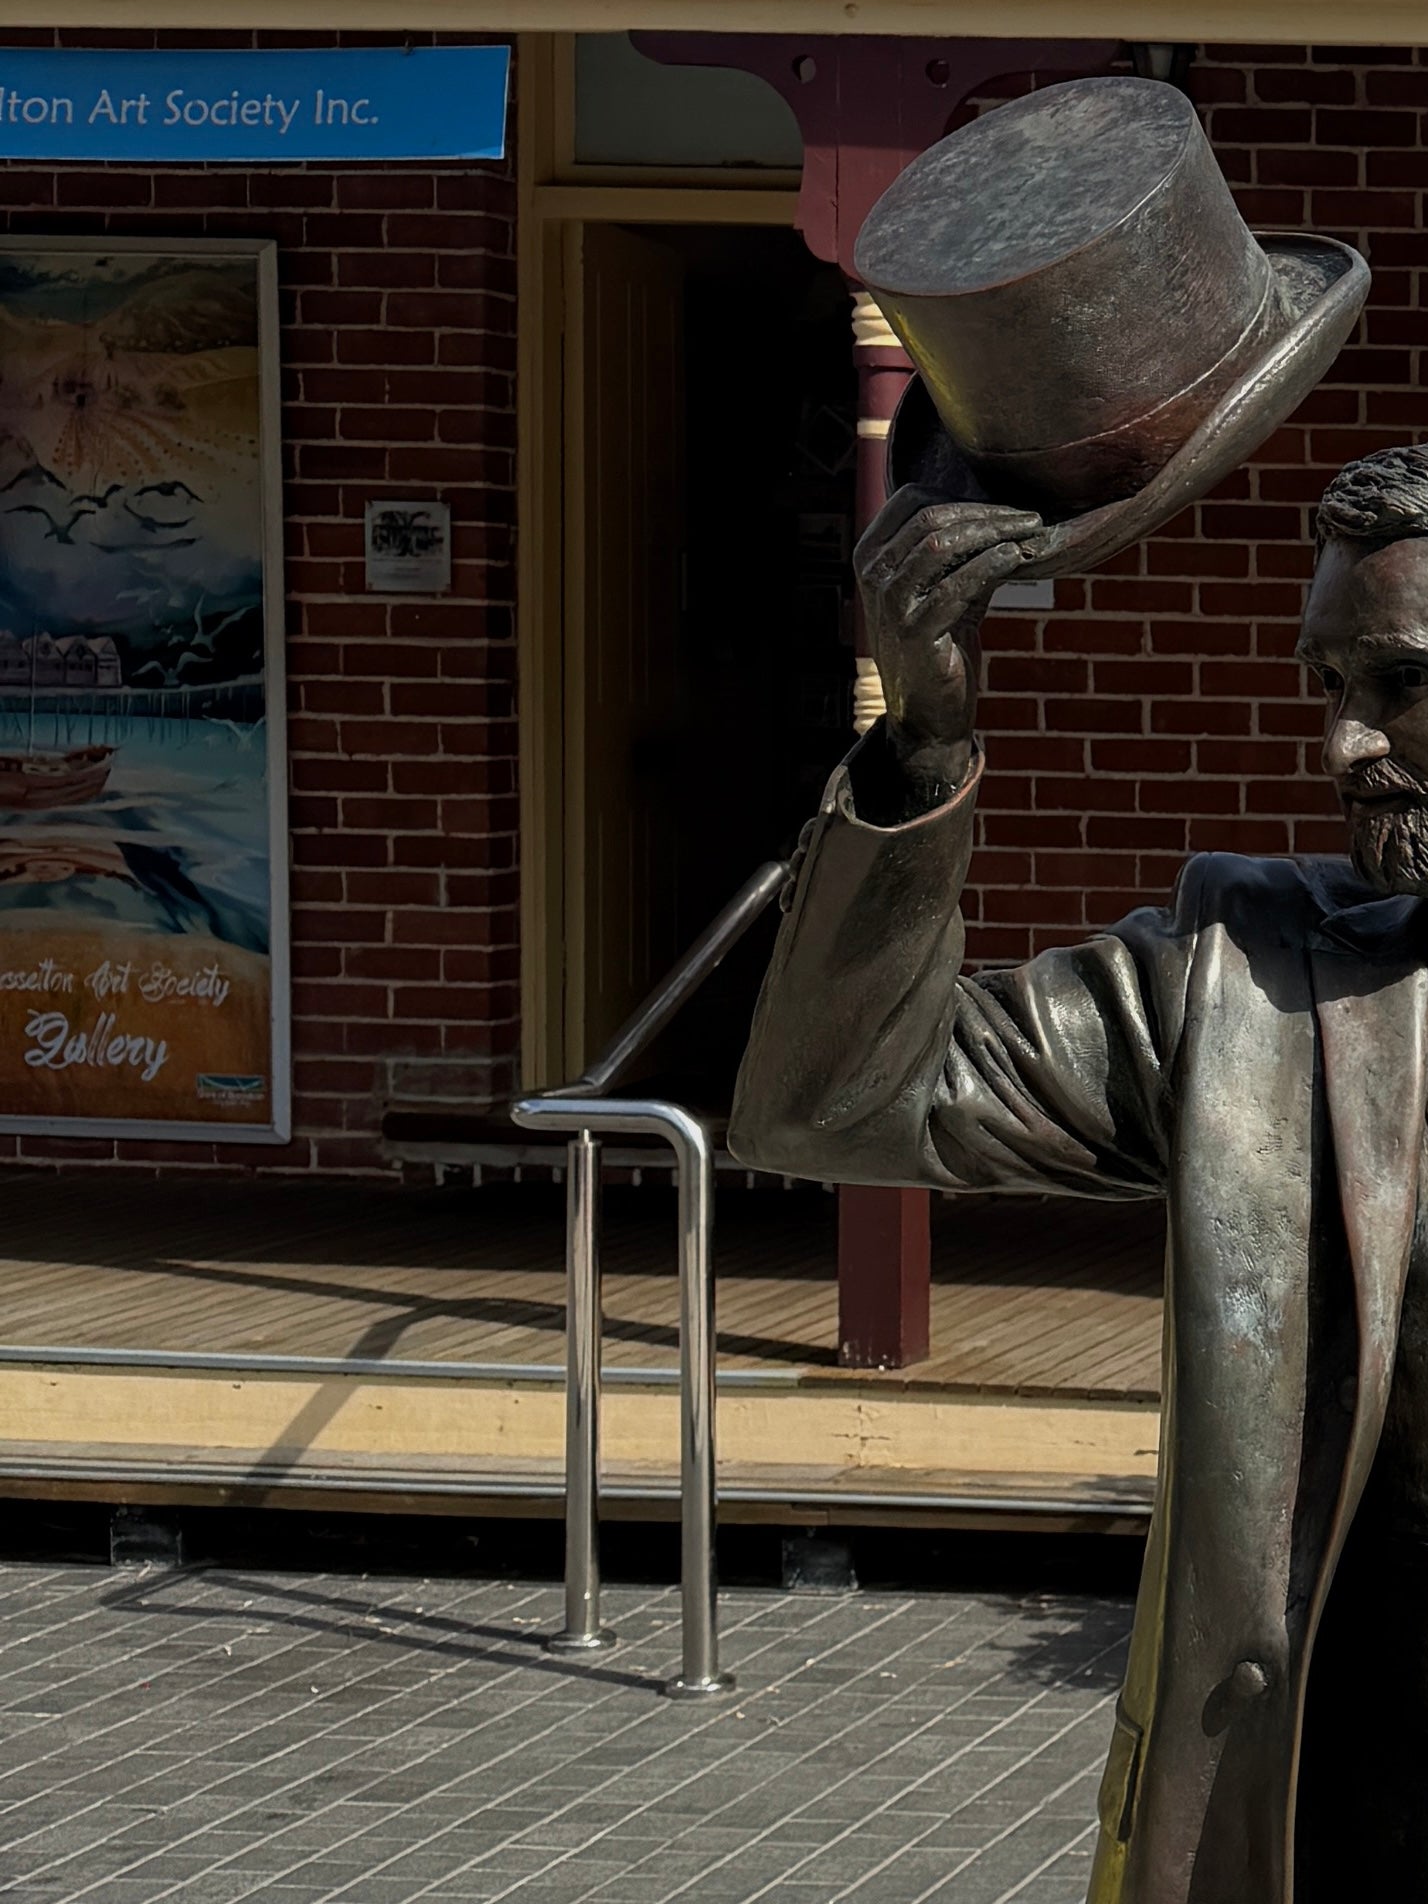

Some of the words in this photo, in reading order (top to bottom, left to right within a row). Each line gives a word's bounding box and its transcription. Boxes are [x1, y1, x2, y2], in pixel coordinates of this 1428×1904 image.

[88, 89, 151, 125] Art
[163, 89, 300, 135] Society
[314, 89, 380, 125] Inc.
[0, 957, 74, 993] sselton
[84, 960, 134, 1002] Art
[138, 960, 230, 1007] Society
[24, 1009, 169, 1082] Gallery
